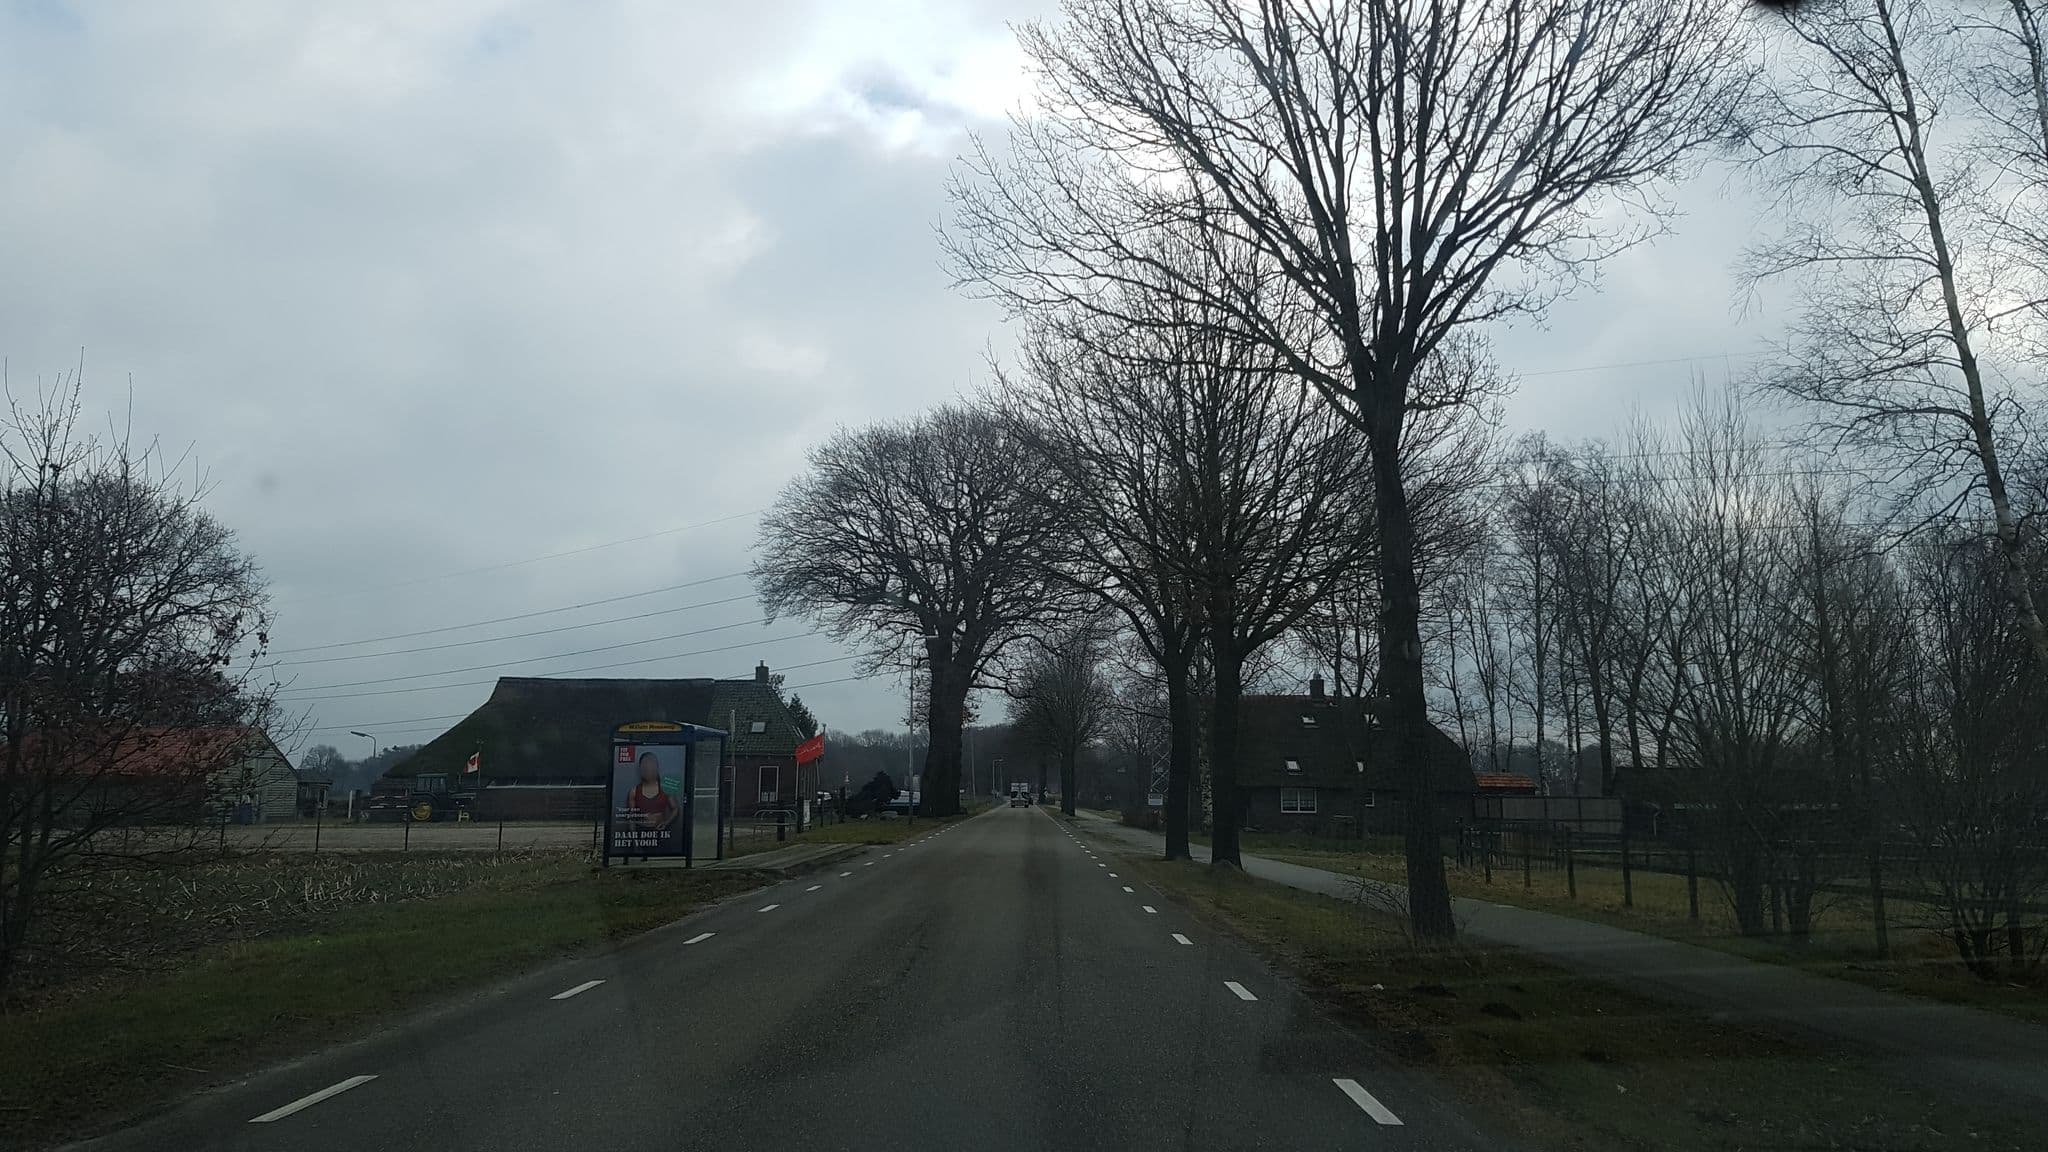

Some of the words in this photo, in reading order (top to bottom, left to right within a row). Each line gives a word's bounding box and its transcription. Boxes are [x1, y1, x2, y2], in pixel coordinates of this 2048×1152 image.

[614, 831, 638, 839] DAAR
[660, 830, 672, 838] IK
[614, 839, 633, 847] HET
[633, 839, 658, 847] VOOR
